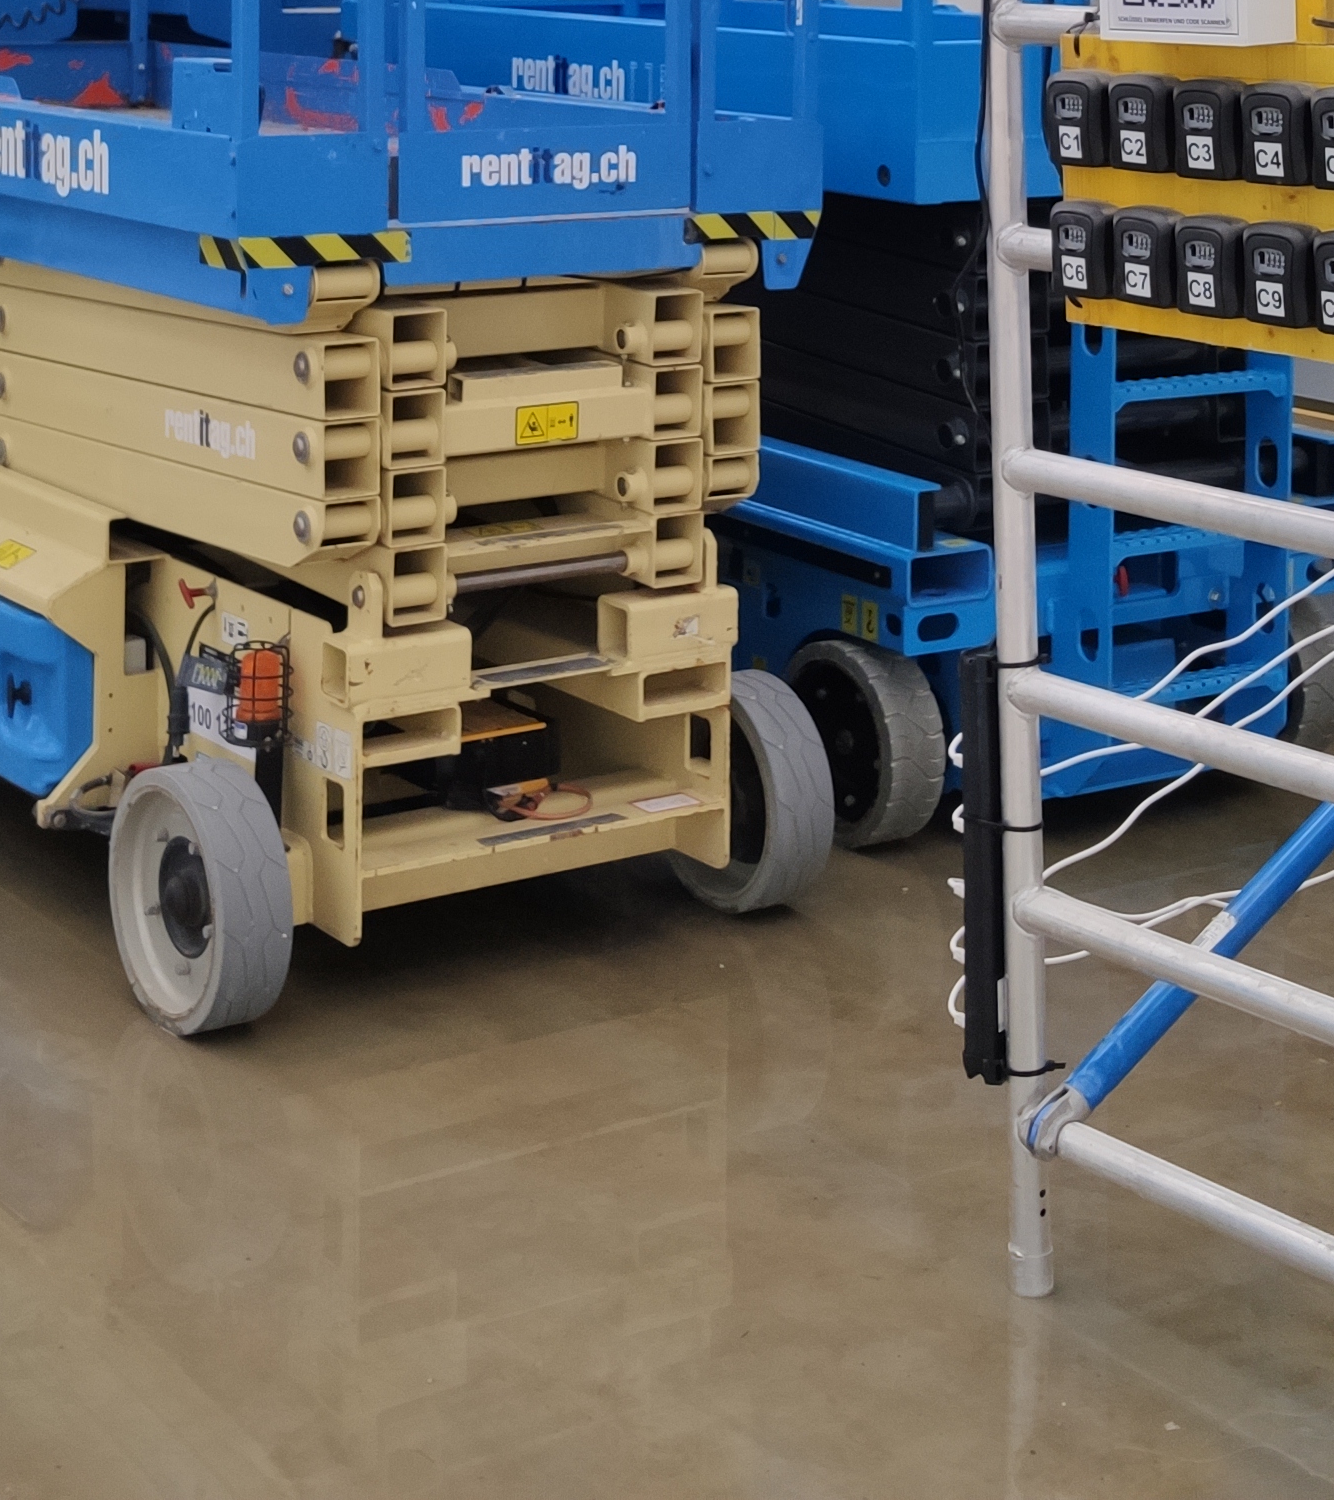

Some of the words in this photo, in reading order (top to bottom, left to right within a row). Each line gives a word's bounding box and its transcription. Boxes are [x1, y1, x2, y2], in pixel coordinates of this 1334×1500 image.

[512, 54, 625, 101] rentitag.ch
[1060, 132, 1081, 151] C1
[1122, 137, 1145, 157] C2
[1188, 142, 1212, 162] C3
[462, 145, 637, 190] rentitag.ch
[1256, 149, 1281, 170] C4
[1063, 262, 1085, 282] C6
[1126, 269, 1148, 290] C7
[1189, 280, 1213, 300] C8
[1258, 289, 1282, 310] C9
[191, 702, 212, 730] 100
